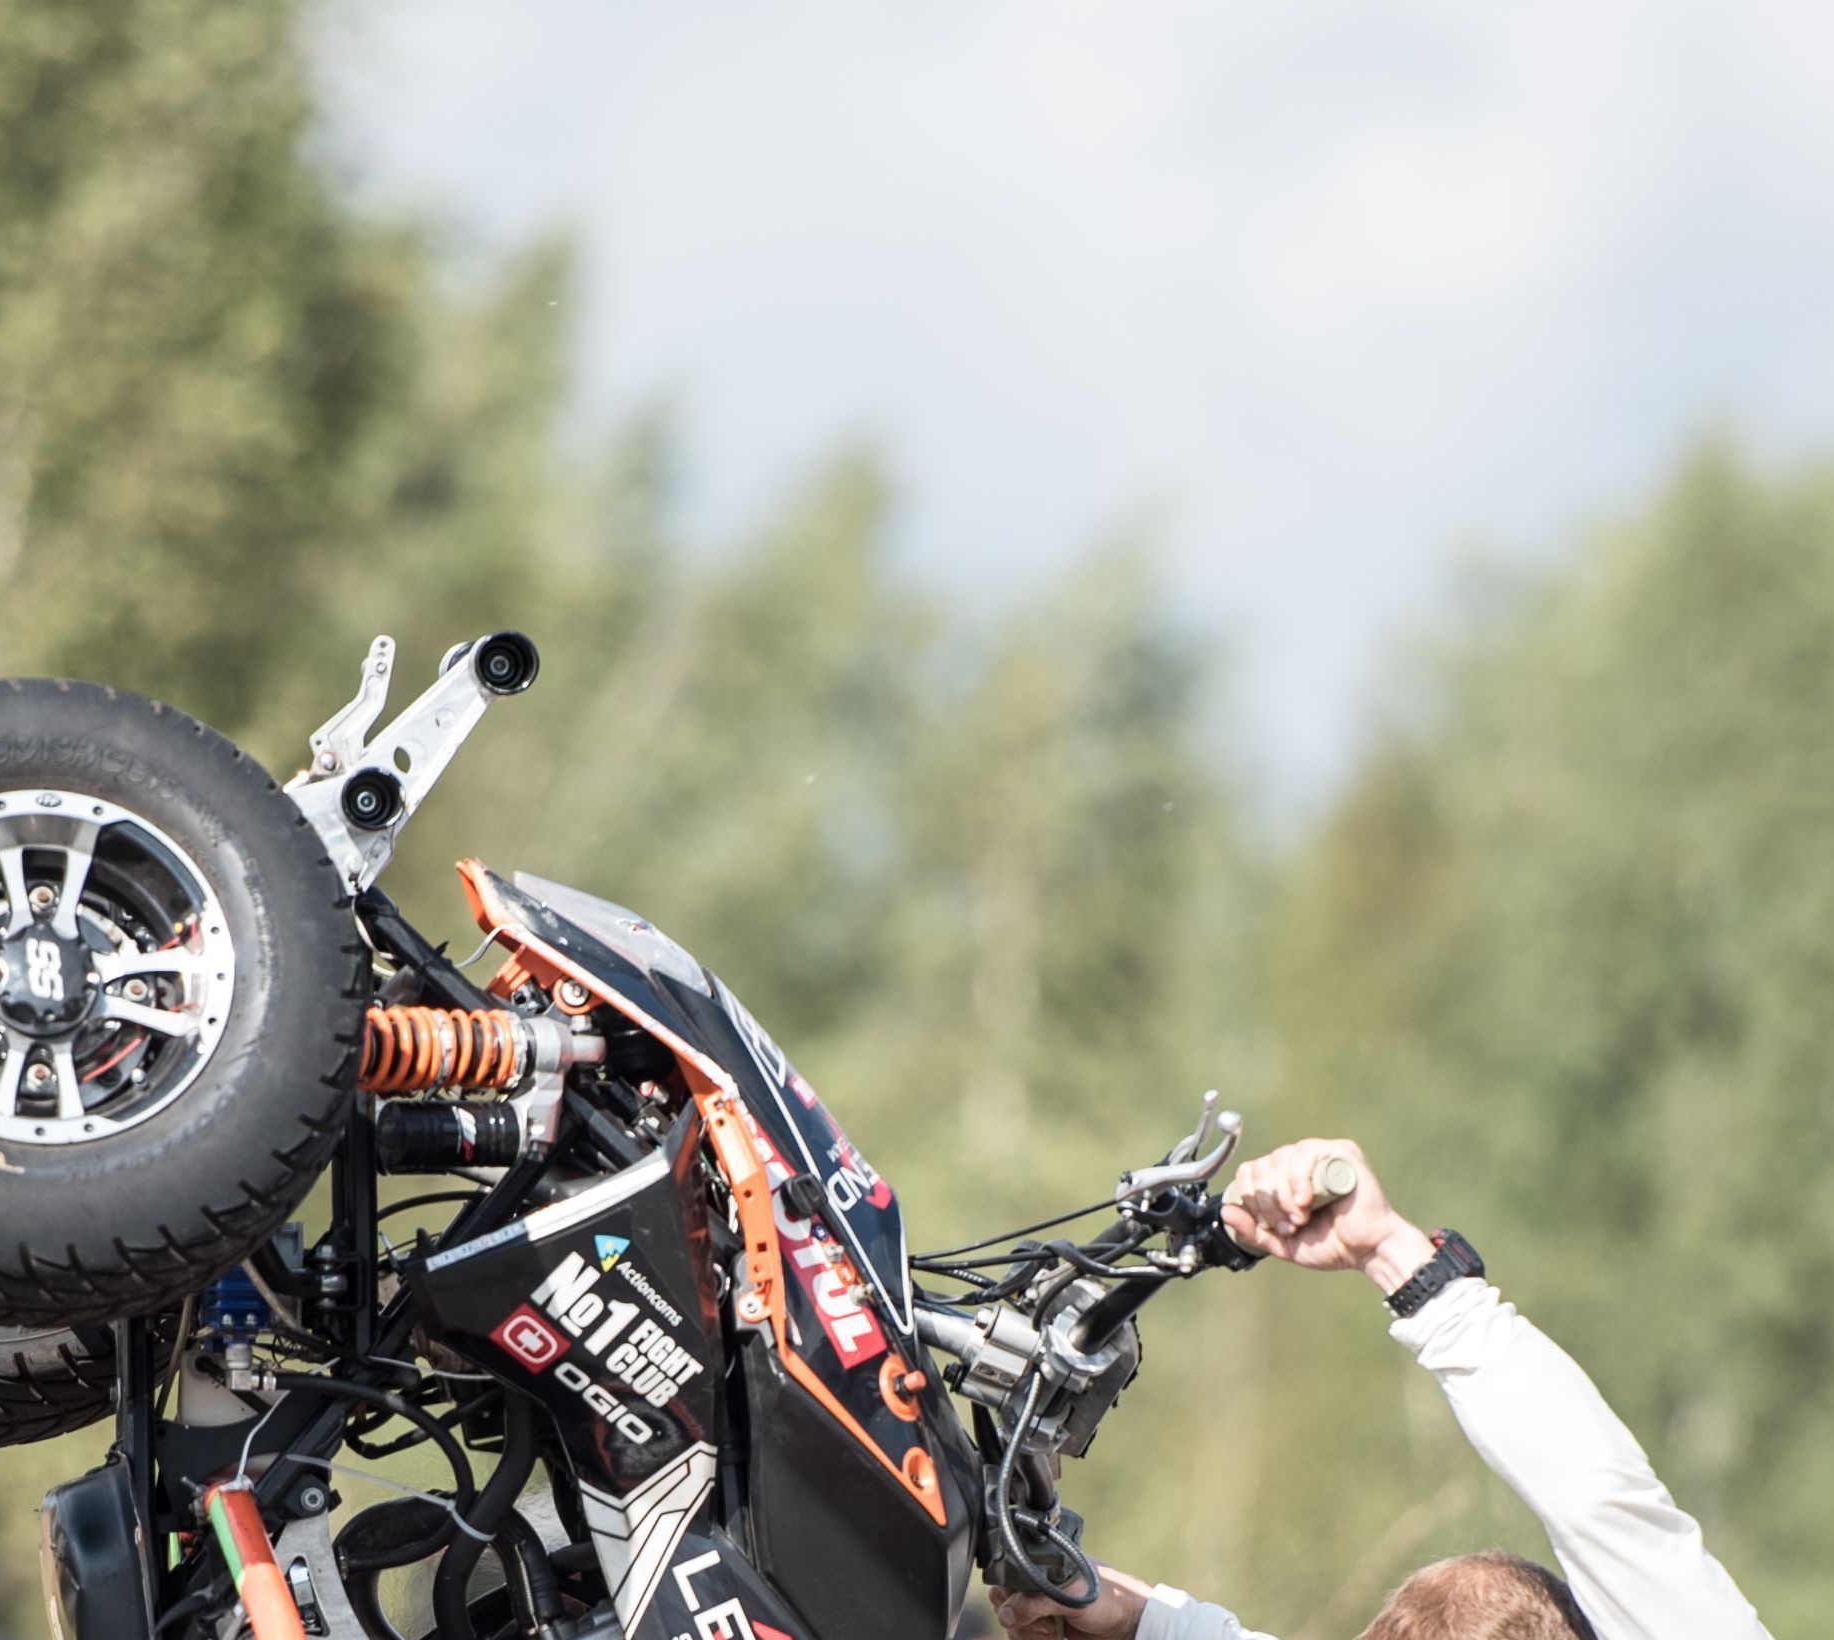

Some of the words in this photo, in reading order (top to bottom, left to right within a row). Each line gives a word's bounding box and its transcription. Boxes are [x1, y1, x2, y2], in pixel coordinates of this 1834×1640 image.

[615, 1260, 683, 1327] Actioncams
[605, 1349, 679, 1408] CLUB
[627, 1325, 704, 1384] FIGHT
[554, 1362, 653, 1445] OGIO
